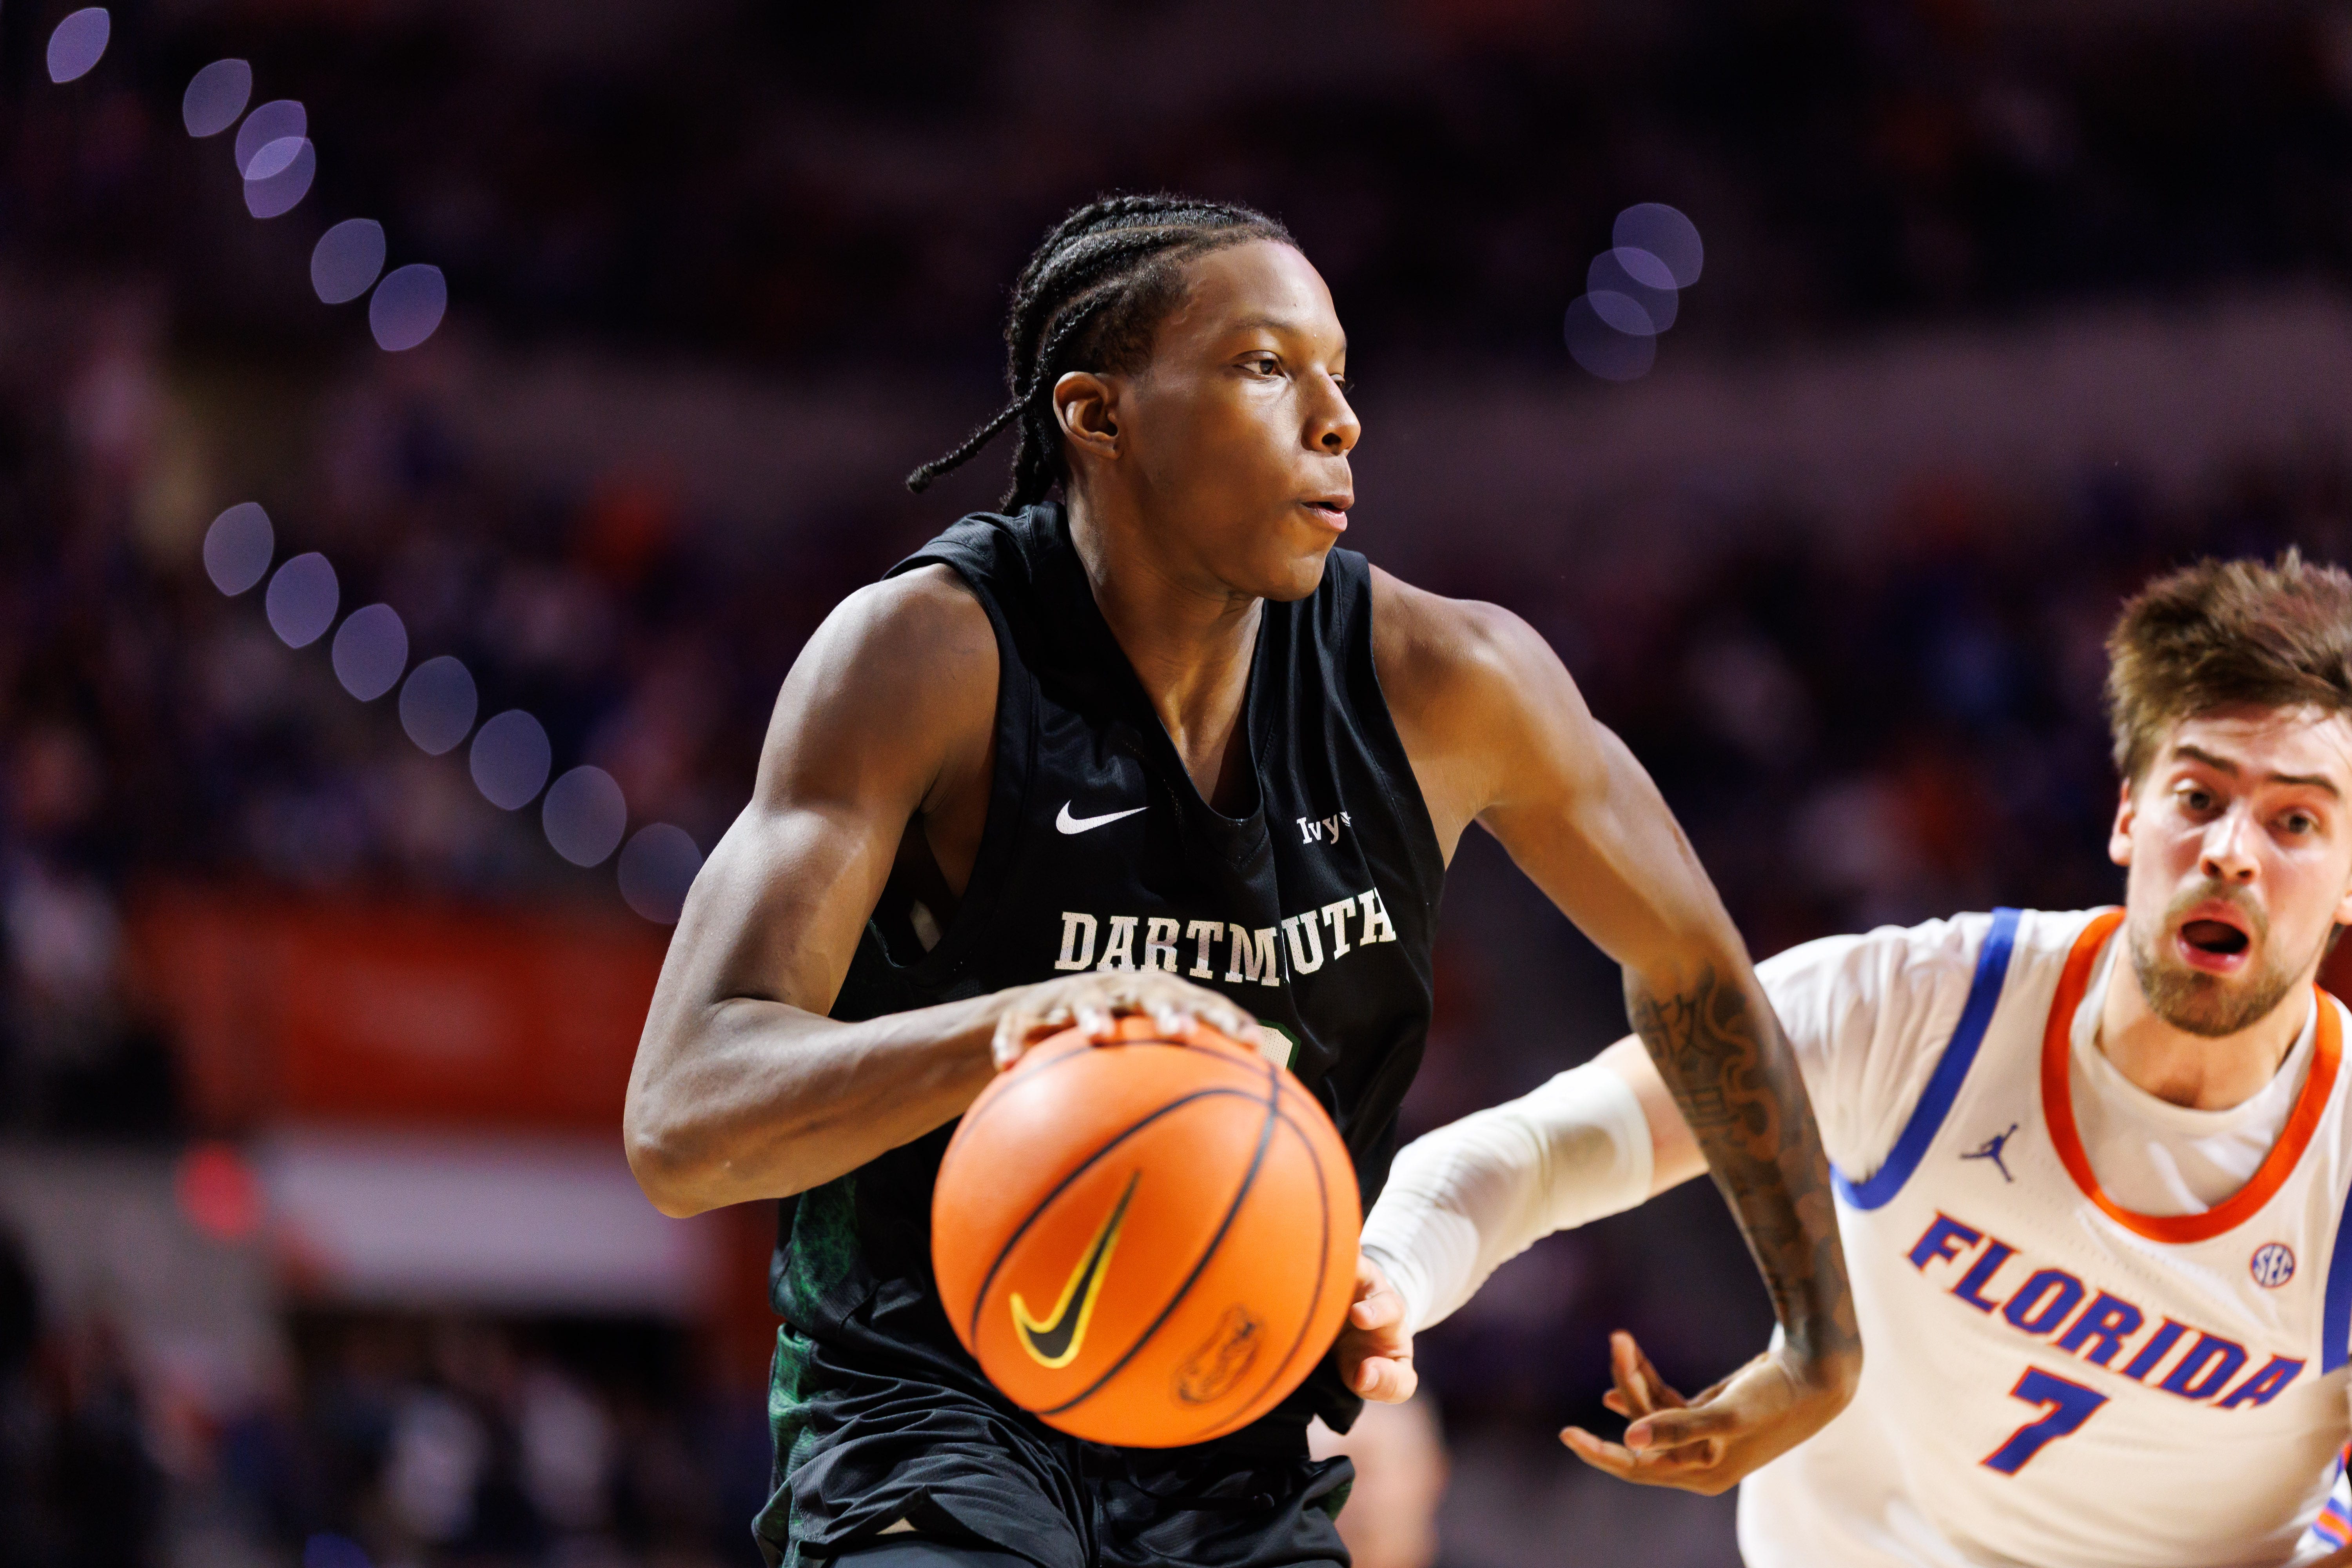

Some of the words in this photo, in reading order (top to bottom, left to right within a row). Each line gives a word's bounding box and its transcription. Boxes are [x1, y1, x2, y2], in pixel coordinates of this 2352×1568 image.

[1296, 814, 1339, 845] Ivy
[1054, 887, 1396, 987] DARTMUTH
[1905, 1210, 2307, 1410] FLORIDA
[2253, 1245, 2295, 1286] SEC
[1978, 1365, 2112, 1477] 7
